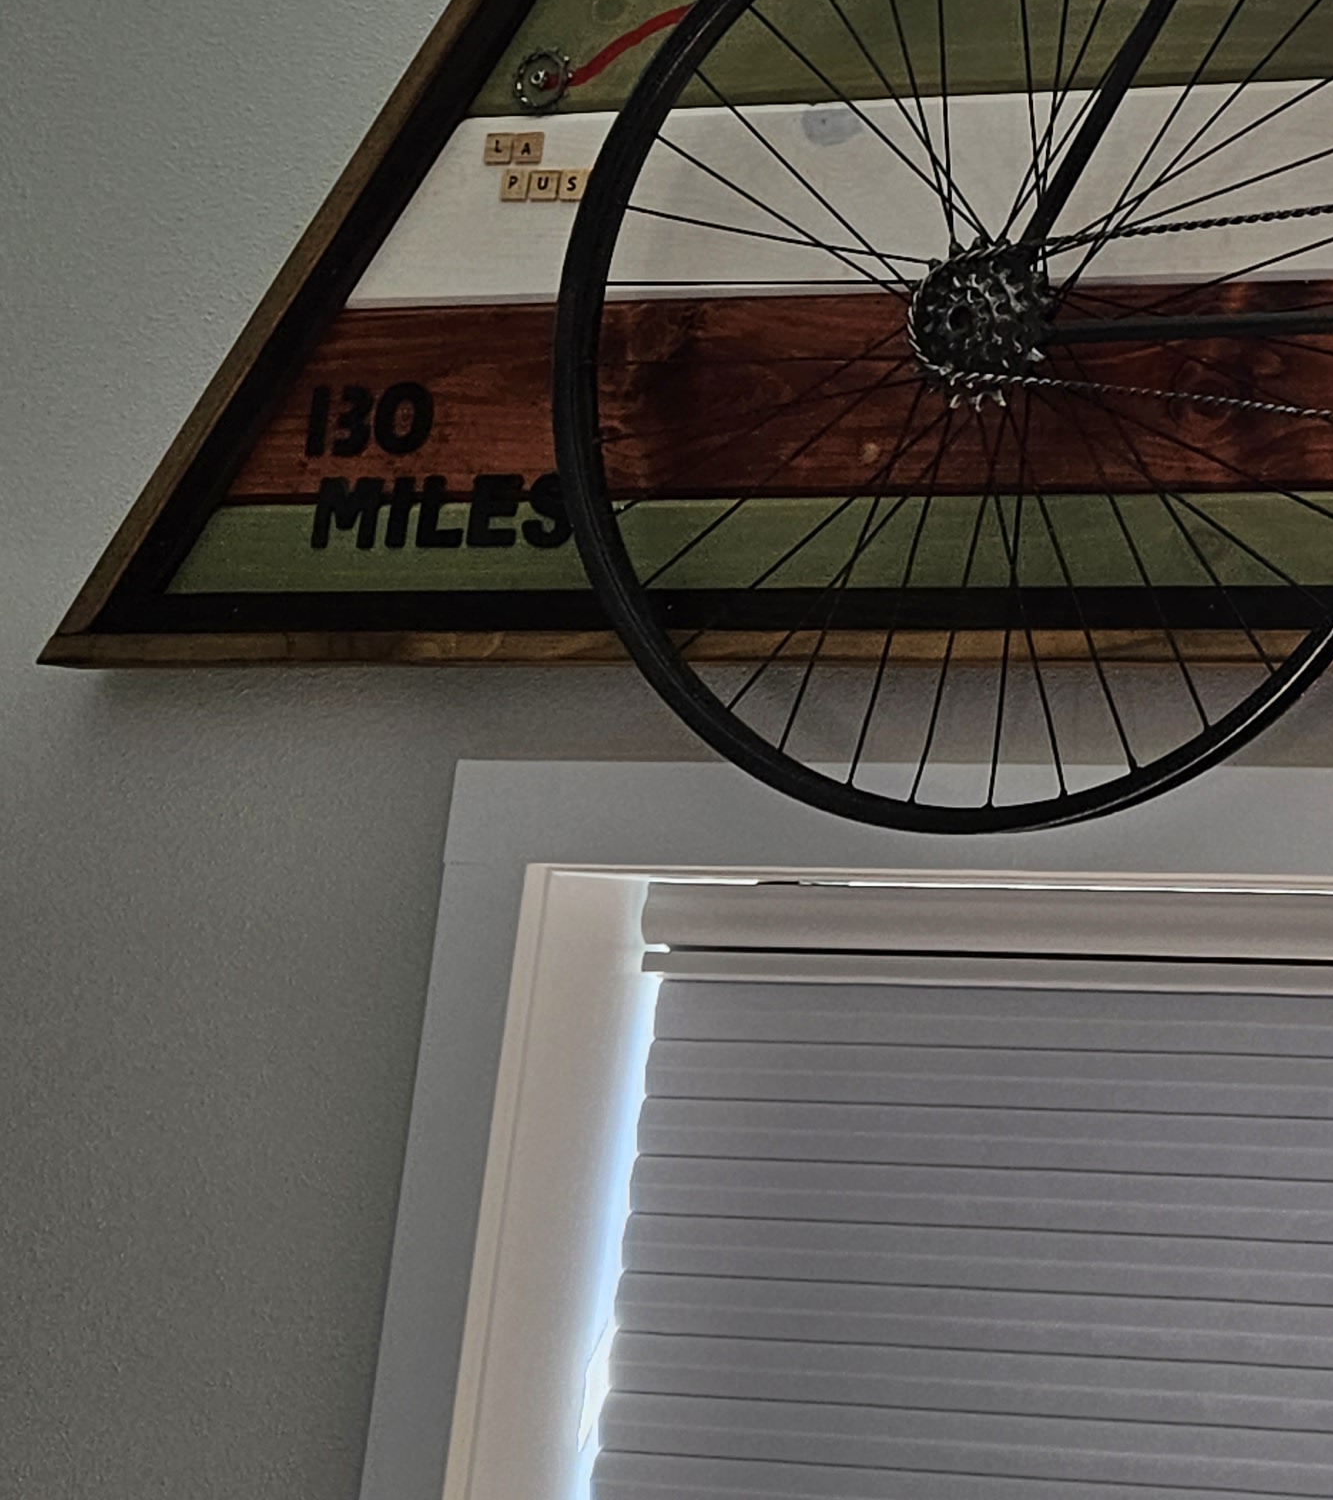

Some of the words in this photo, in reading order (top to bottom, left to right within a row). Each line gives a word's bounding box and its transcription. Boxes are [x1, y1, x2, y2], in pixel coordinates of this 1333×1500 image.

[493, 139, 531, 156] LA
[507, 175, 578, 192] PUS
[304, 381, 435, 458] 130
[310, 472, 575, 549] MILES
